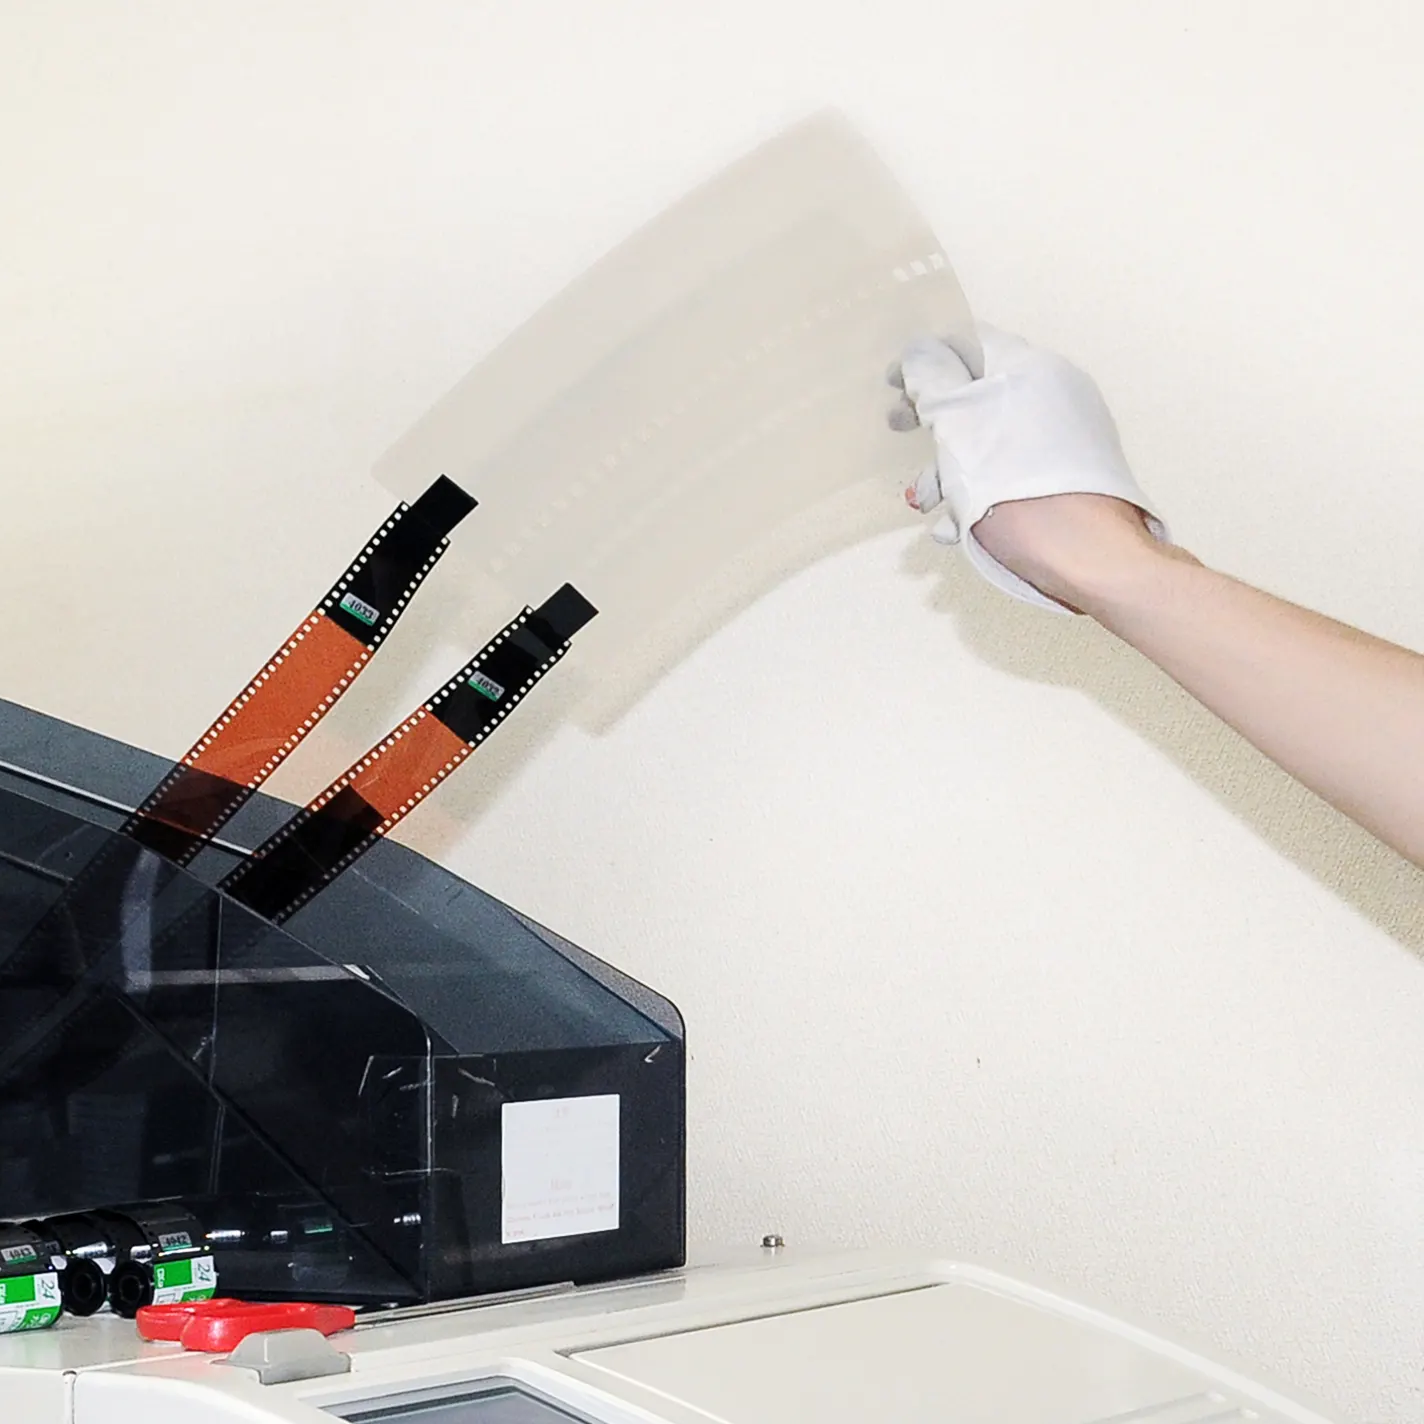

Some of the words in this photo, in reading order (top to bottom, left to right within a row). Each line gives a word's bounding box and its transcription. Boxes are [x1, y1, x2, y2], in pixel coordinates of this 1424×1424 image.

[346, 598, 375, 620] 4033
[197, 1263, 211, 1281] 24
[41, 1279, 55, 1300] 24
